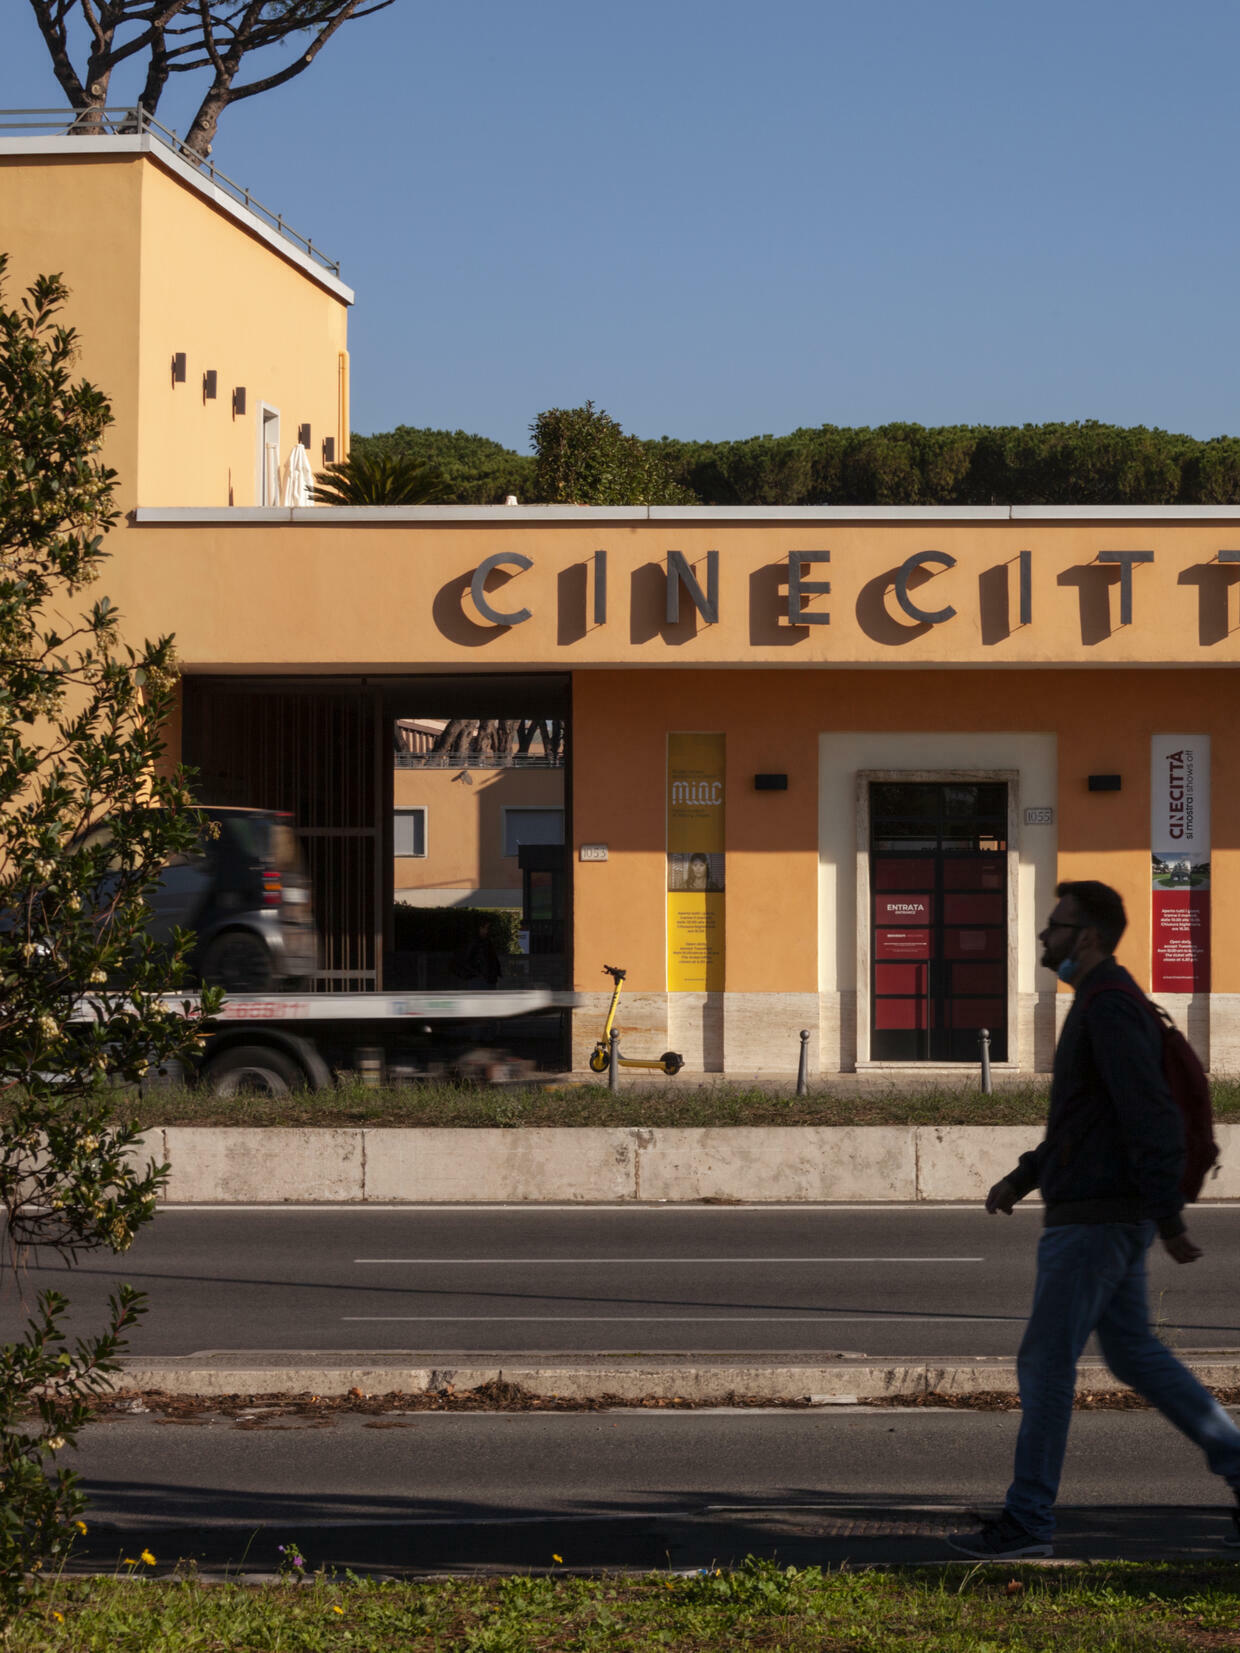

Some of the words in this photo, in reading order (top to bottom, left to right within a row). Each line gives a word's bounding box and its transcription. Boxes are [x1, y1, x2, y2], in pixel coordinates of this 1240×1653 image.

[1166, 750, 1184, 839] CINECITTÀ
[1185, 764, 1194, 793] shows
[1185, 797, 1194, 831] mostra
